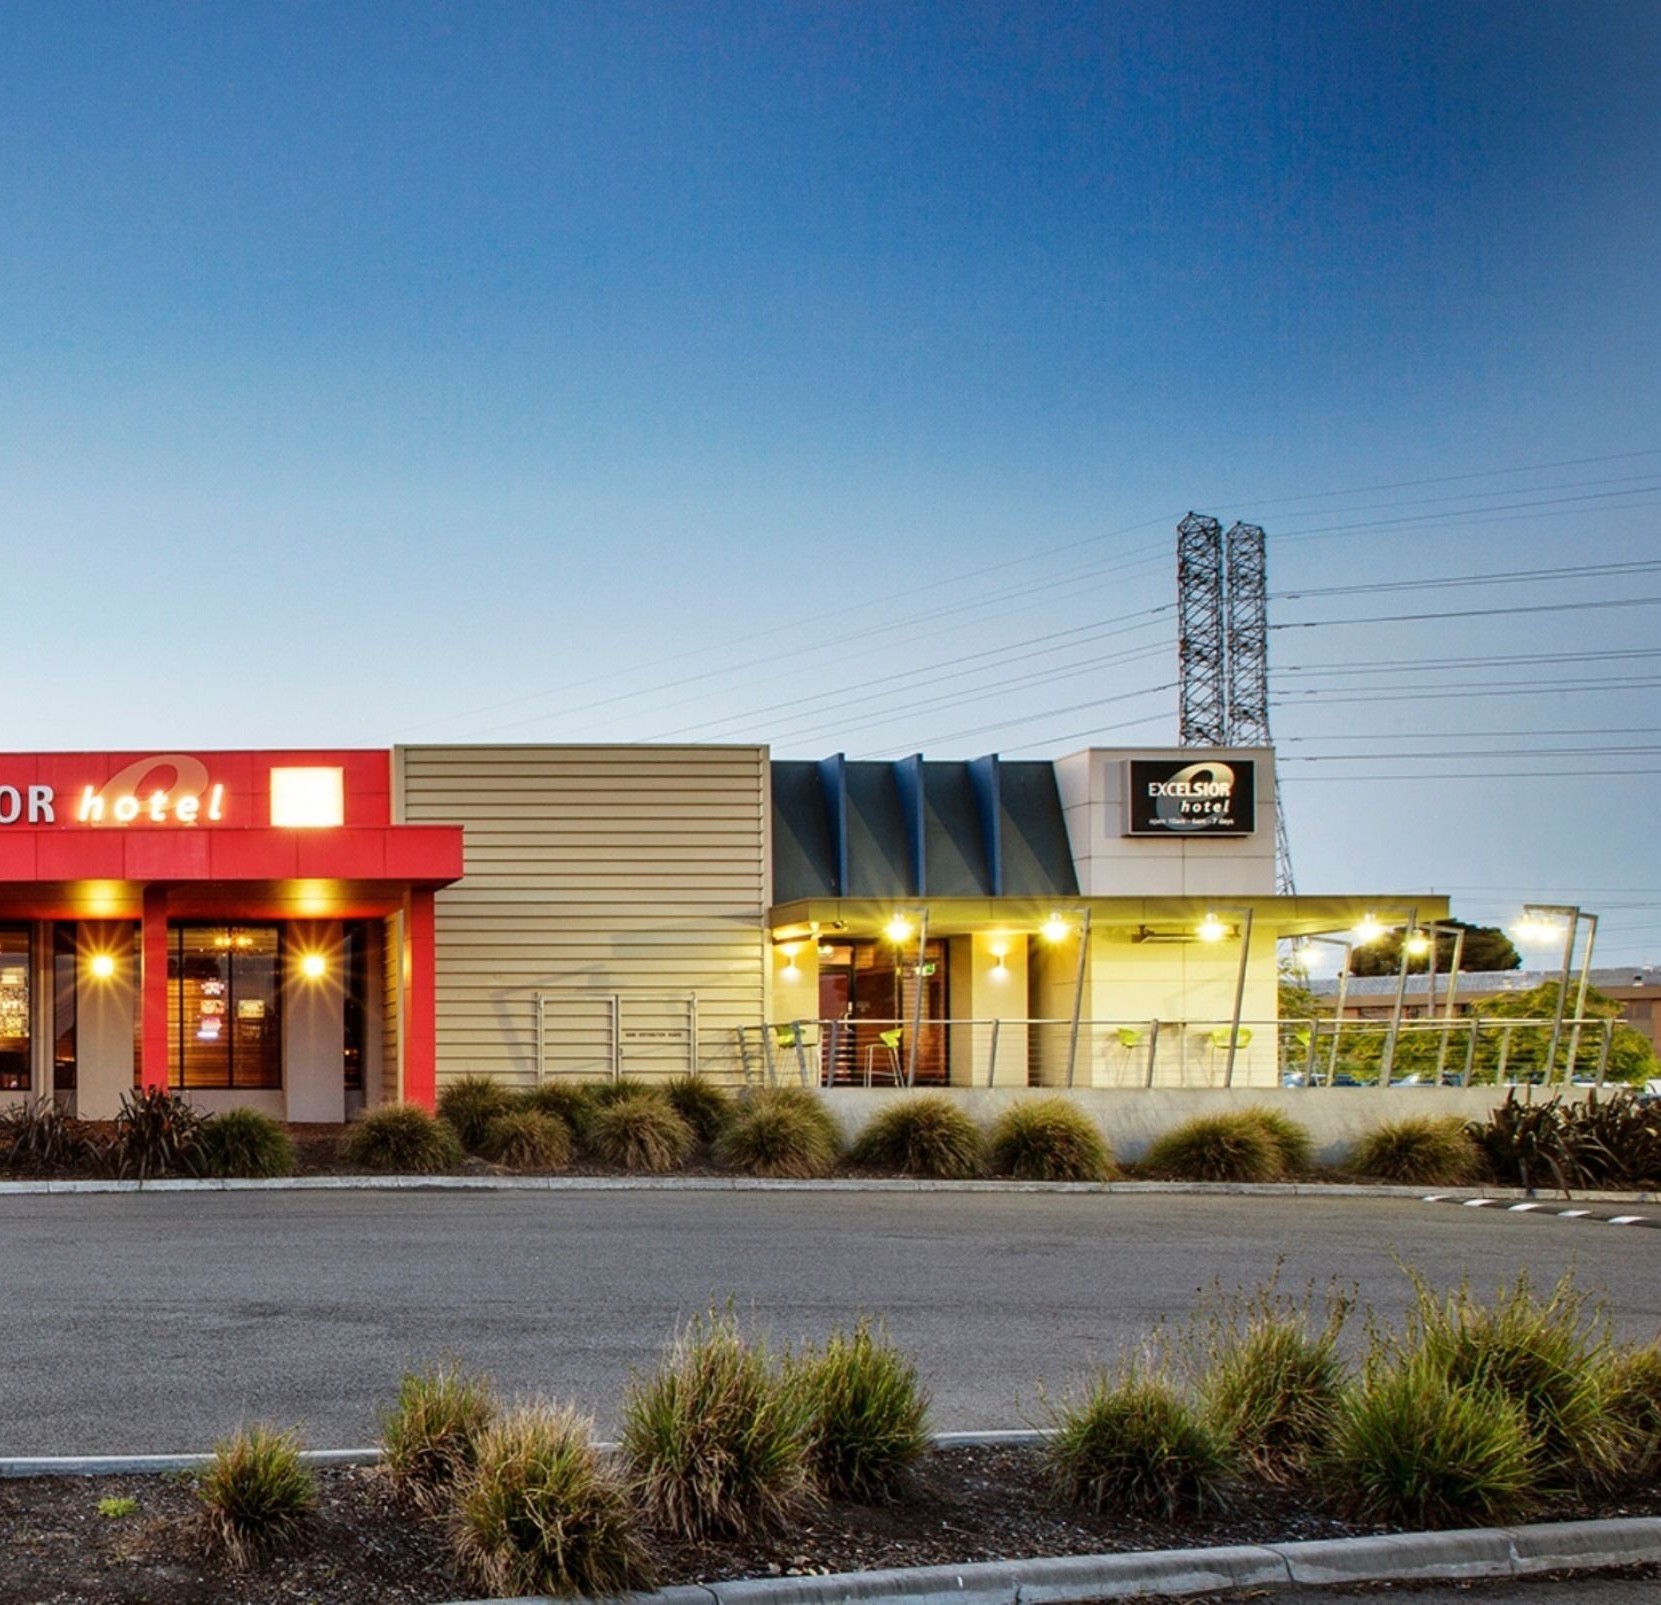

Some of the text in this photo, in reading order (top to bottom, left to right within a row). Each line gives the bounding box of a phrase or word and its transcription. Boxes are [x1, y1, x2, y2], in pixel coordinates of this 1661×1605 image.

[1148, 782, 1231, 797] EXCELSIOR
[77, 784, 224, 823] hotel
[1180, 799, 1231, 813] hotel
